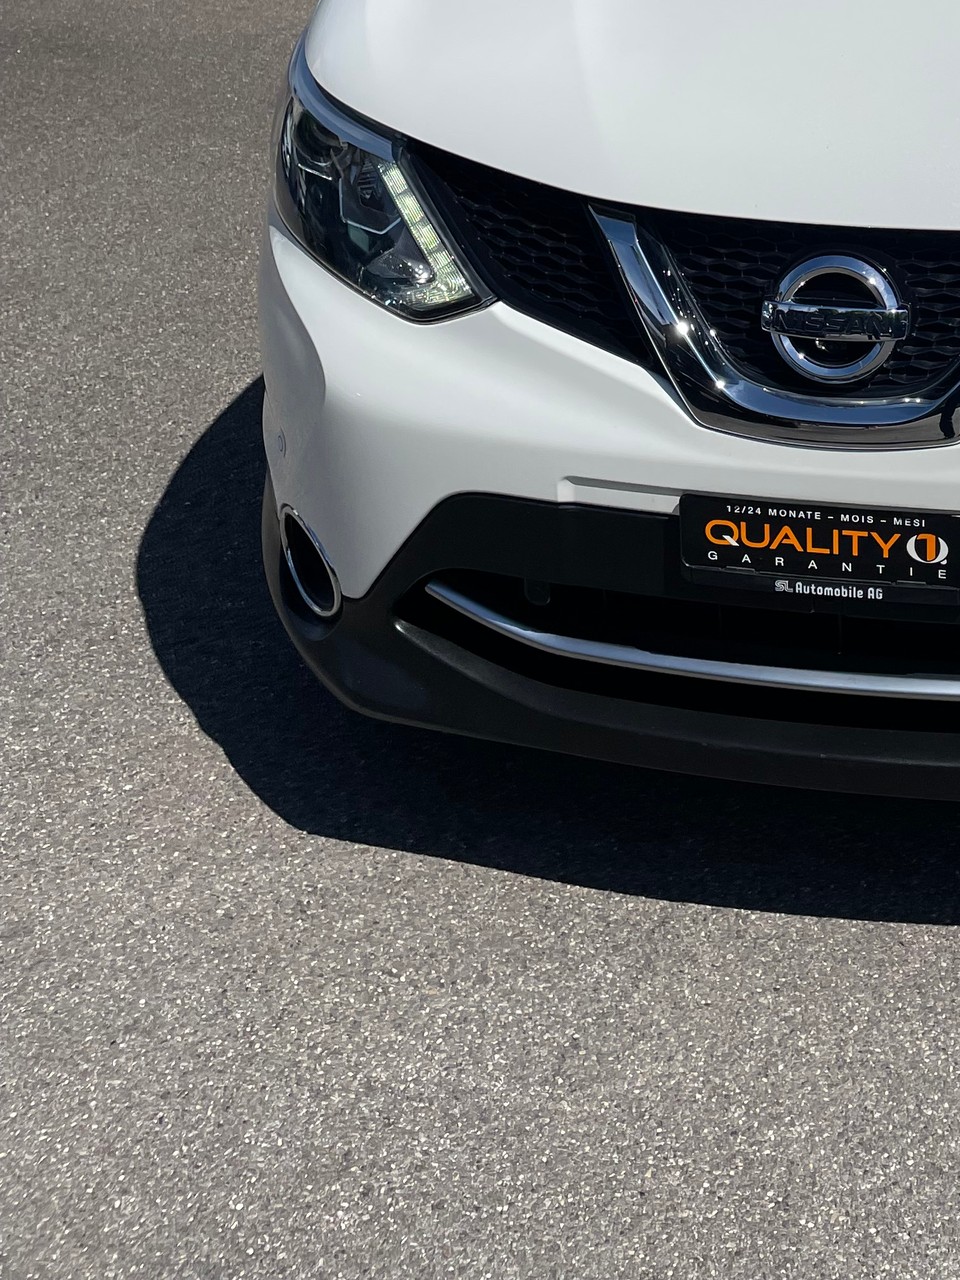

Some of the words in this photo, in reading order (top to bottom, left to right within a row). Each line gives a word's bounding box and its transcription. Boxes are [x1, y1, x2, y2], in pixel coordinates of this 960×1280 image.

[726, 504, 762, 516] 12/24
[768, 508, 822, 521] MONATE
[840, 514, 874, 525] MOIS
[893, 518, 926, 528] MESI
[705, 519, 901, 558] QUALITY
[795, 582, 864, 599] Automobile
[867, 588, 883, 600] AG
